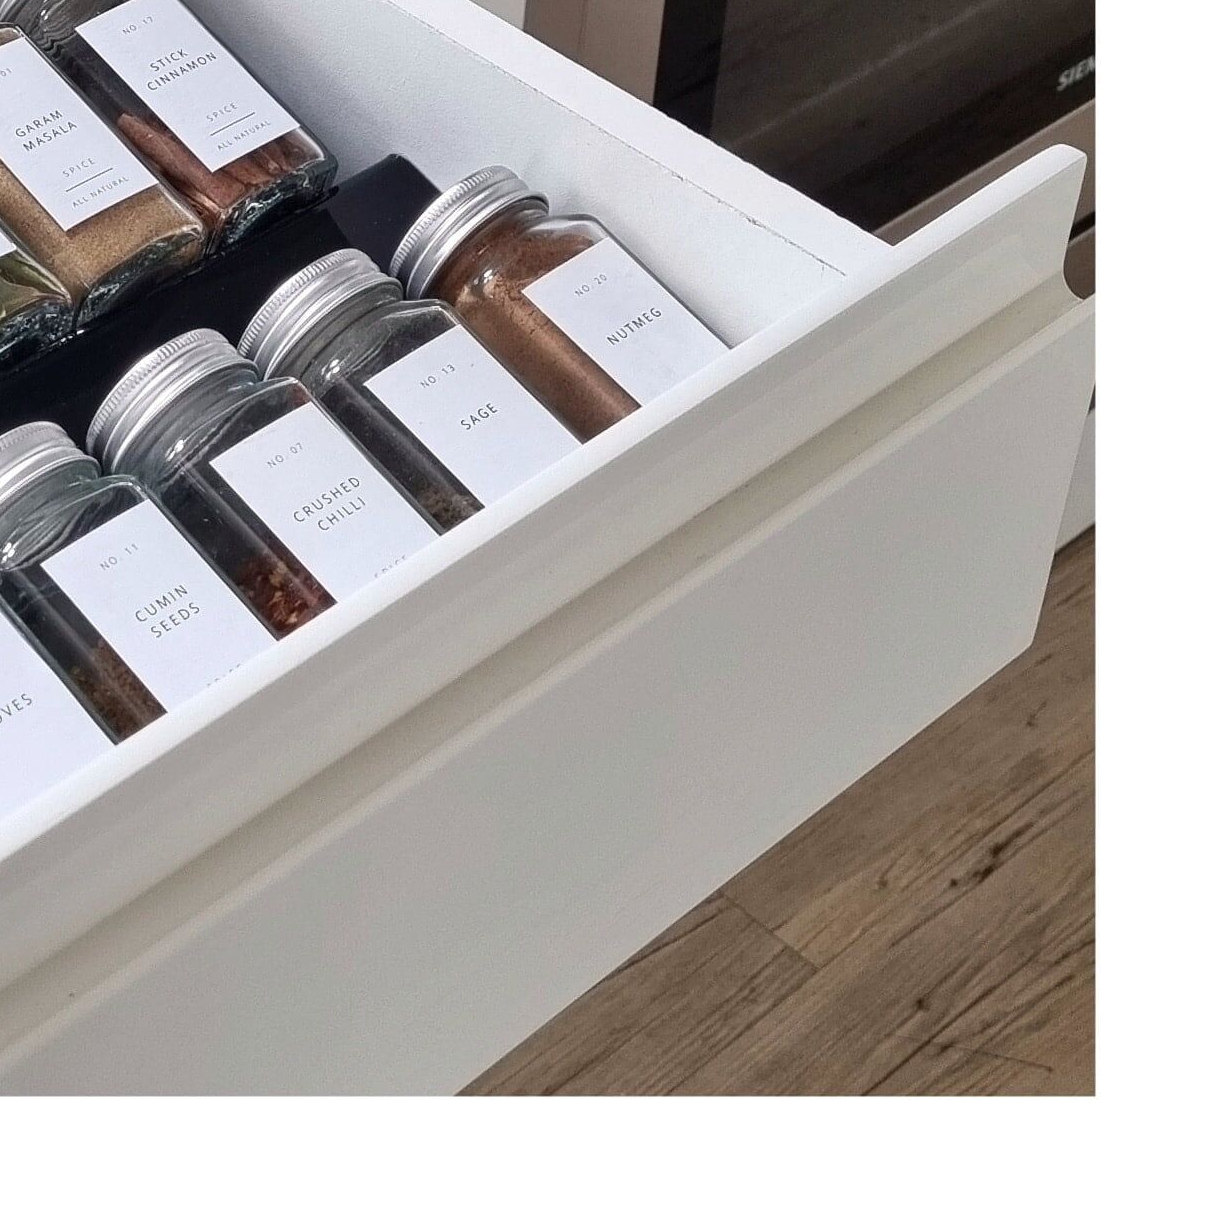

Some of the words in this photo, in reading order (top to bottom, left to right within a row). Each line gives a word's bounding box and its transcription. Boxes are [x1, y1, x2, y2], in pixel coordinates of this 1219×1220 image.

[0, 67, 13, 78] 01
[147, 52, 217, 91] CINNAMON
[150, 48, 189, 72] STICK
[15, 109, 64, 138] GARAM
[206, 102, 239, 123] SPICE
[22, 121, 78, 152] MASALA
[217, 139, 234, 151] ALL
[235, 120, 272, 143] NATURAL
[62, 156, 96, 178] SPICE
[72, 195, 89, 208] ALL
[90, 175, 129, 199] NATURAL
[593, 273, 607, 285] 20
[606, 307, 662, 346] NUTMEG
[441, 363, 455, 376] 13
[460, 402, 499, 430] SAGE
[290, 442, 303, 454] 07
[293, 476, 361, 523] CRUSHED
[317, 496, 366, 532] CHILLI
[124, 542, 139, 555] 11
[135, 584, 188, 622] CUMIN
[150, 602, 200, 638] SEEDS
